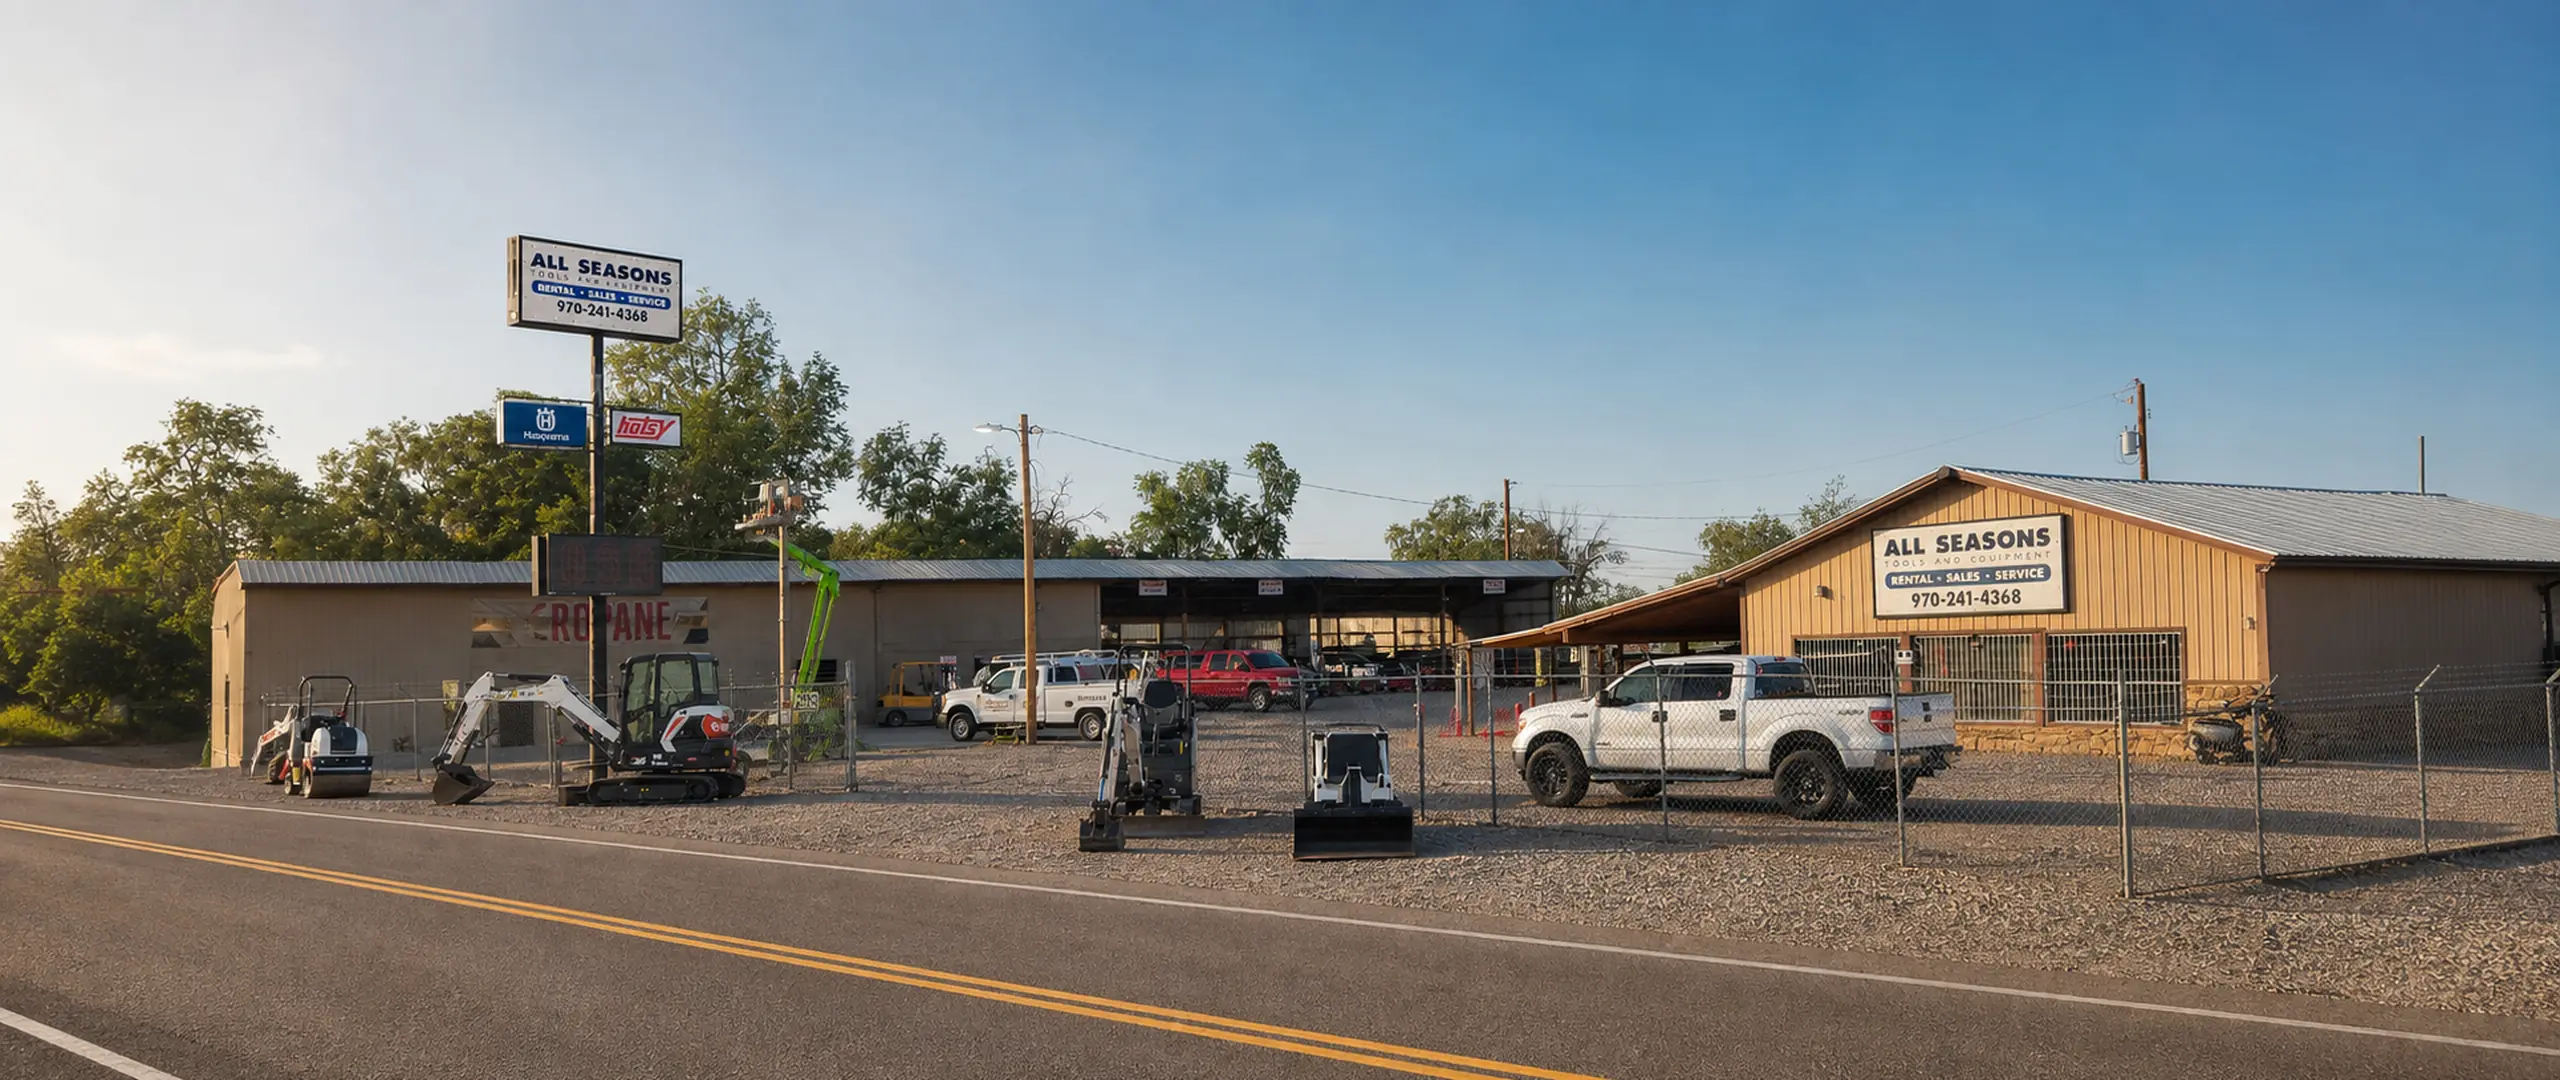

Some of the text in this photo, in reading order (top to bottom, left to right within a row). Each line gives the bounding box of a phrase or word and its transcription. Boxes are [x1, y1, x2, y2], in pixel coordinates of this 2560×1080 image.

[530, 253, 672, 286] ALL SEASONS
[557, 300, 648, 323] 970-241-4368
[1884, 527, 2051, 557] ALL SEASONS
[1891, 567, 2045, 586] RENTAL SALES SERVICE
[1911, 588, 2022, 608] 970-241-4368
